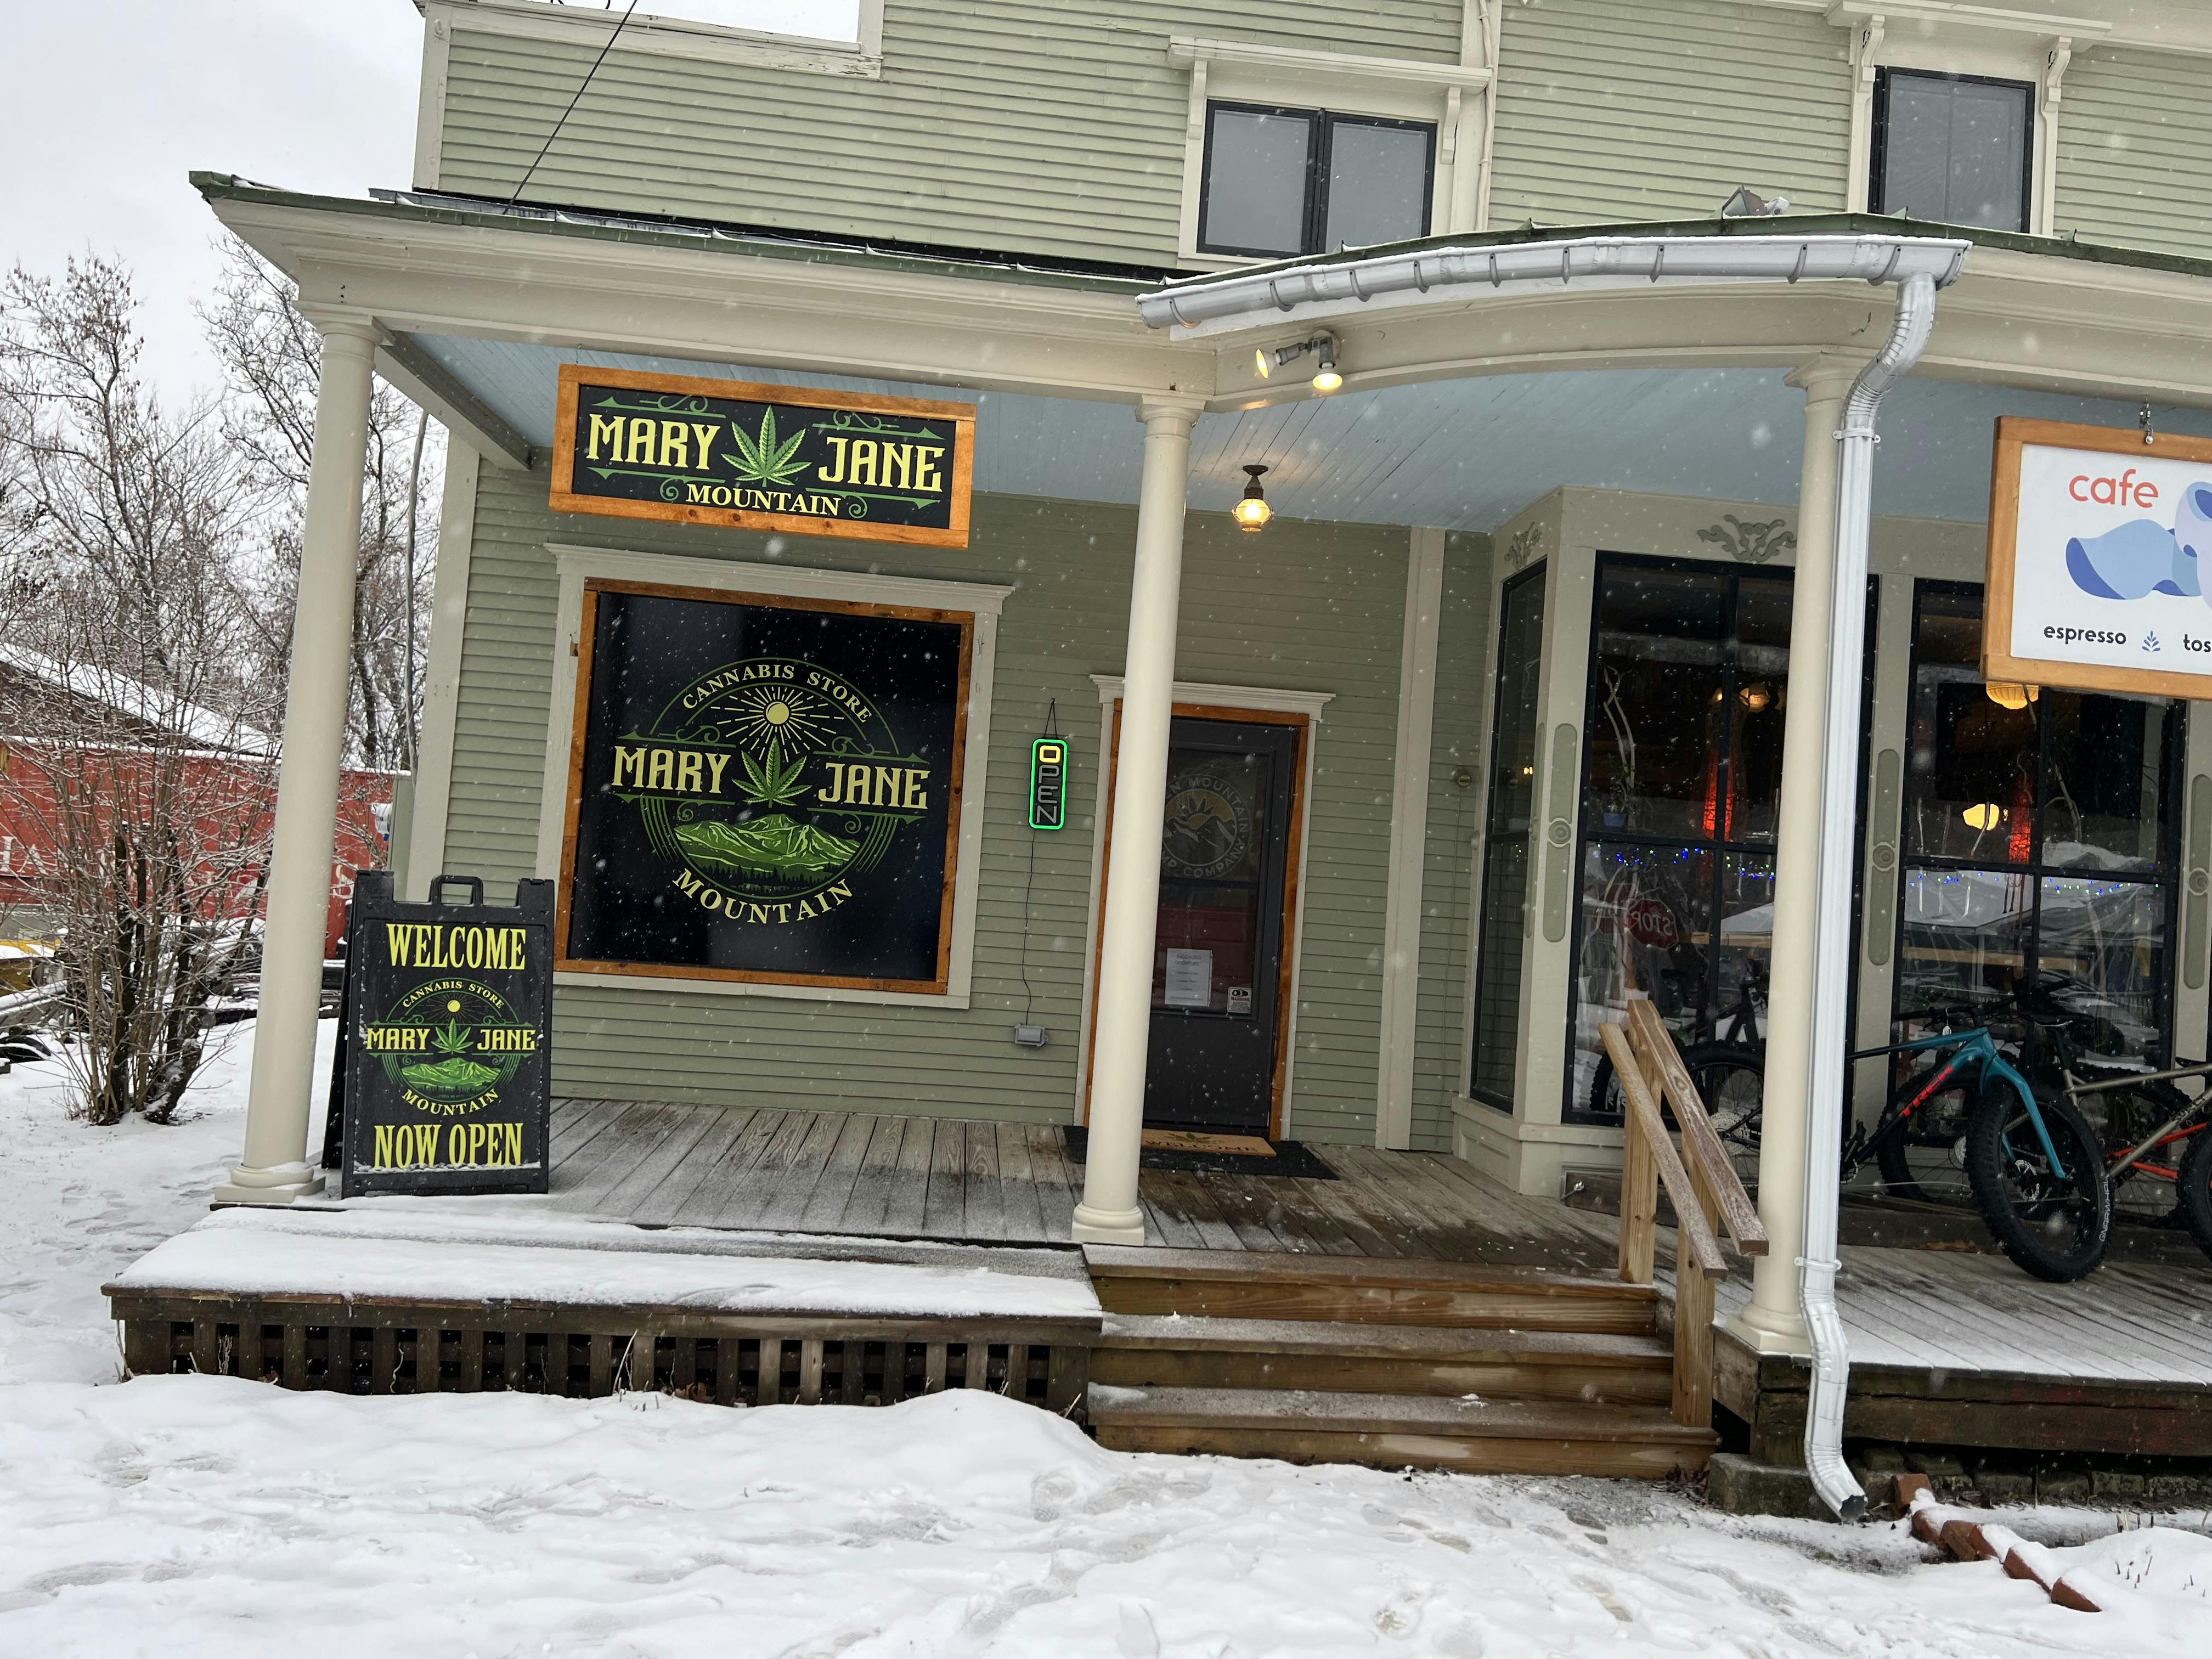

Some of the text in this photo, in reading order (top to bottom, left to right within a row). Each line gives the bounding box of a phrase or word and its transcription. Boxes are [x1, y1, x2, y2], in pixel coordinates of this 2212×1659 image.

[586, 414, 945, 493] MARY JANE
[684, 483, 842, 517] MOUNTAIN
[2069, 469, 2159, 509] cafe
[2044, 625, 2127, 645] espresso
[682, 664, 873, 724] CANNABIS STORE
[612, 746, 931, 810] MARY JANE
[1035, 744, 1061, 825] OPEN
[1188, 777, 1248, 833] MOUNTAIN
[1183, 838, 1246, 878] COMPANY
[672, 868, 854, 924] MOUNTAIN
[386, 923, 526, 970] WELCOME
[402, 980, 505, 1009] CANNABIS STORE
[365, 1028, 537, 1051] MARY JANE
[401, 1088, 499, 1116] MOUNTAIN
[374, 1122, 524, 1170] NOW OPEN
